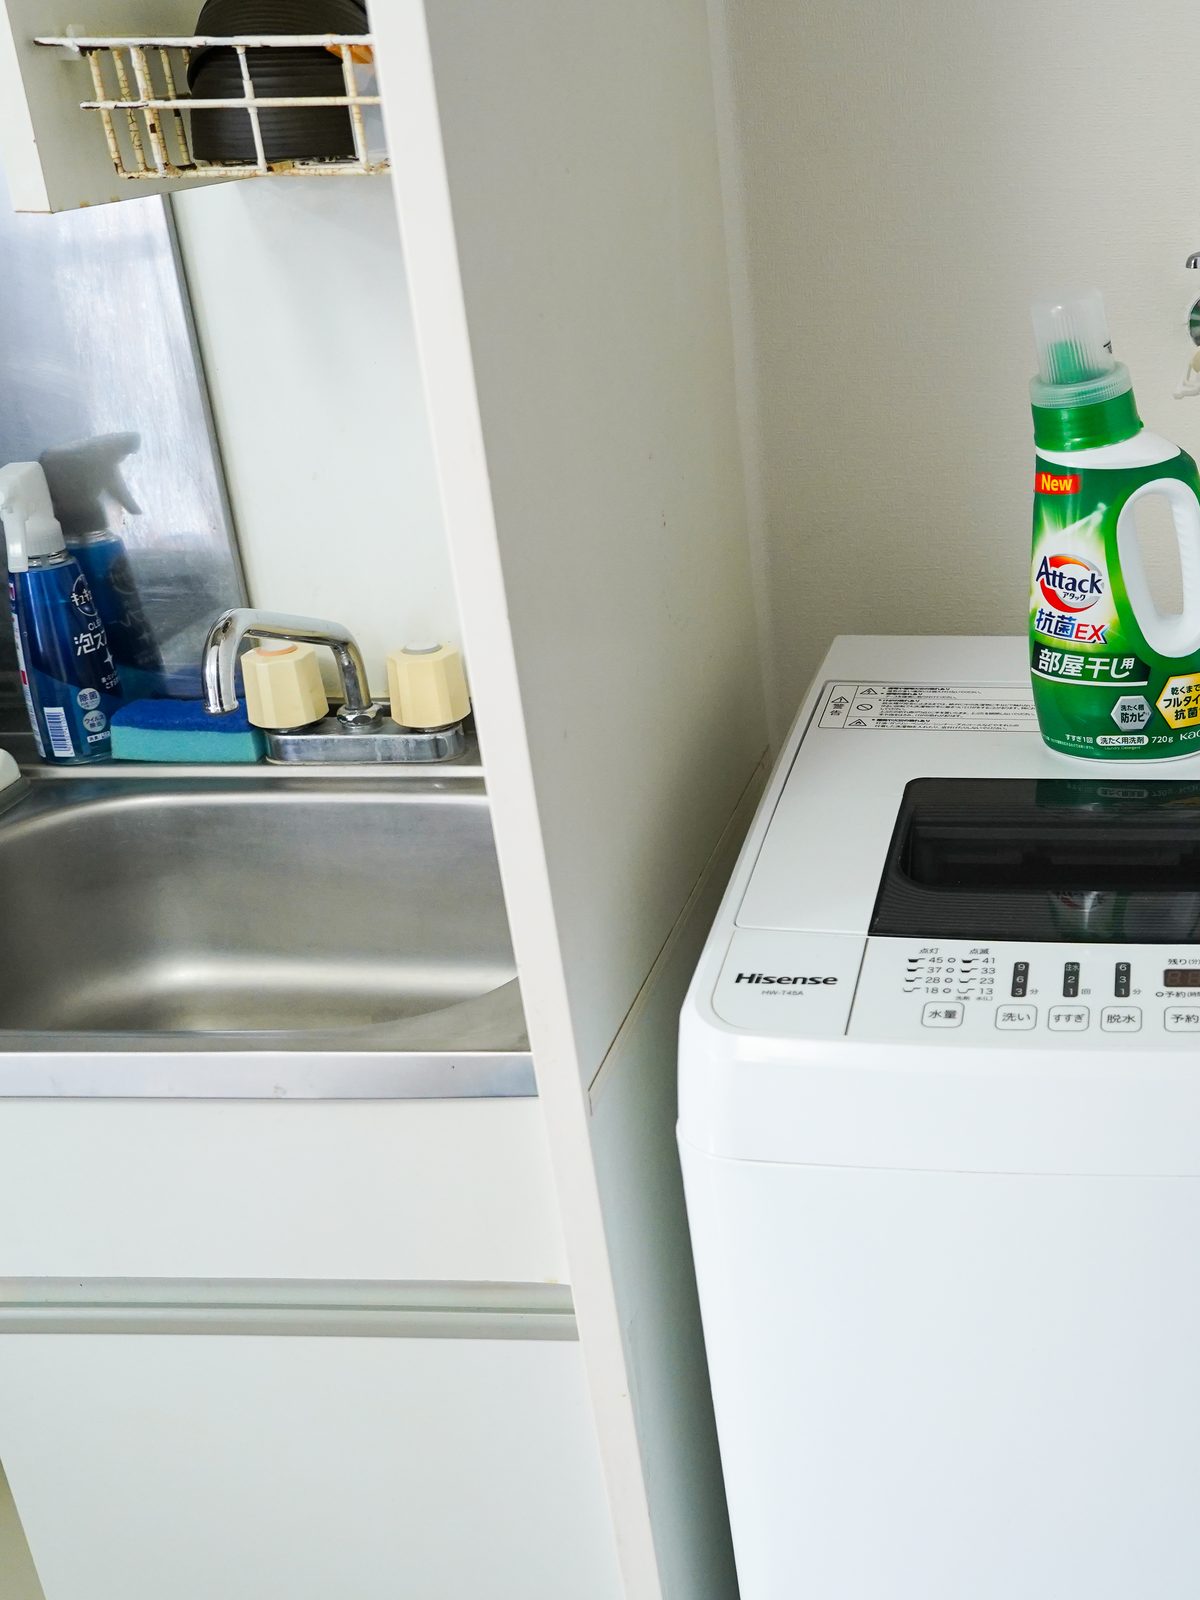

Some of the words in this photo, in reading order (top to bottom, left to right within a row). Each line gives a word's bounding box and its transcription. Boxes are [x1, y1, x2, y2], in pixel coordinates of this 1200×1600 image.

[1041, 474, 1073, 491] New
[1035, 555, 1103, 594] Attack
[1062, 591, 1086, 601] アタック
[1036, 608, 1106, 642] 抗菌EX
[1038, 648, 1136, 679] 部屋干し用
[1170, 683, 1200, 696] 乾くまで
[1120, 712, 1145, 724] 防カビ
[1174, 706, 1198, 721] 抗菌
[1100, 736, 1145, 745] 洗たく用洗剤
[927, 966, 942, 974] 37
[735, 973, 838, 985] Hisense
[925, 976, 941, 984] 28
[979, 977, 995, 985] 23
[928, 1010, 957, 1019] 水量
[1002, 1012, 1031, 1022] 洗い
[1053, 1013, 1085, 1023] すすぎ
[1106, 1014, 1136, 1024] 脱水
[1171, 1014, 1200, 1024] 予約
